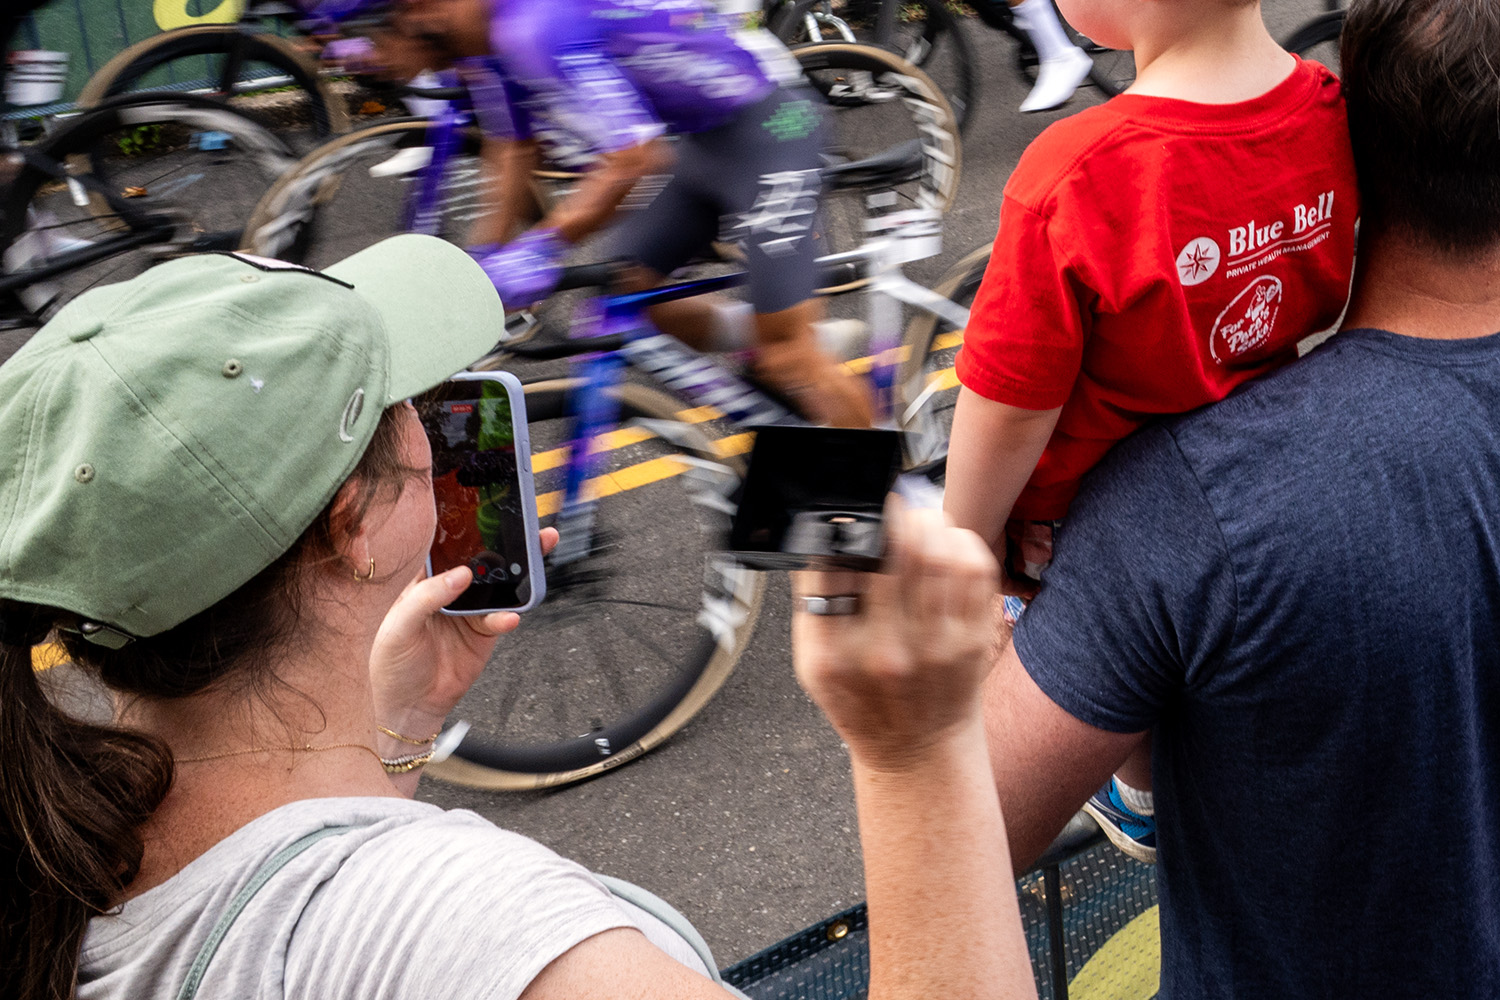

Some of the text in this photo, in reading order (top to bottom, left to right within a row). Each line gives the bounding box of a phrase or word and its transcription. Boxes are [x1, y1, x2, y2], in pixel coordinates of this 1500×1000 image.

[1228, 190, 1335, 257] Blue Bell
[1226, 231, 1331, 279] PRIVATE WEALTH MANAGEMENT
